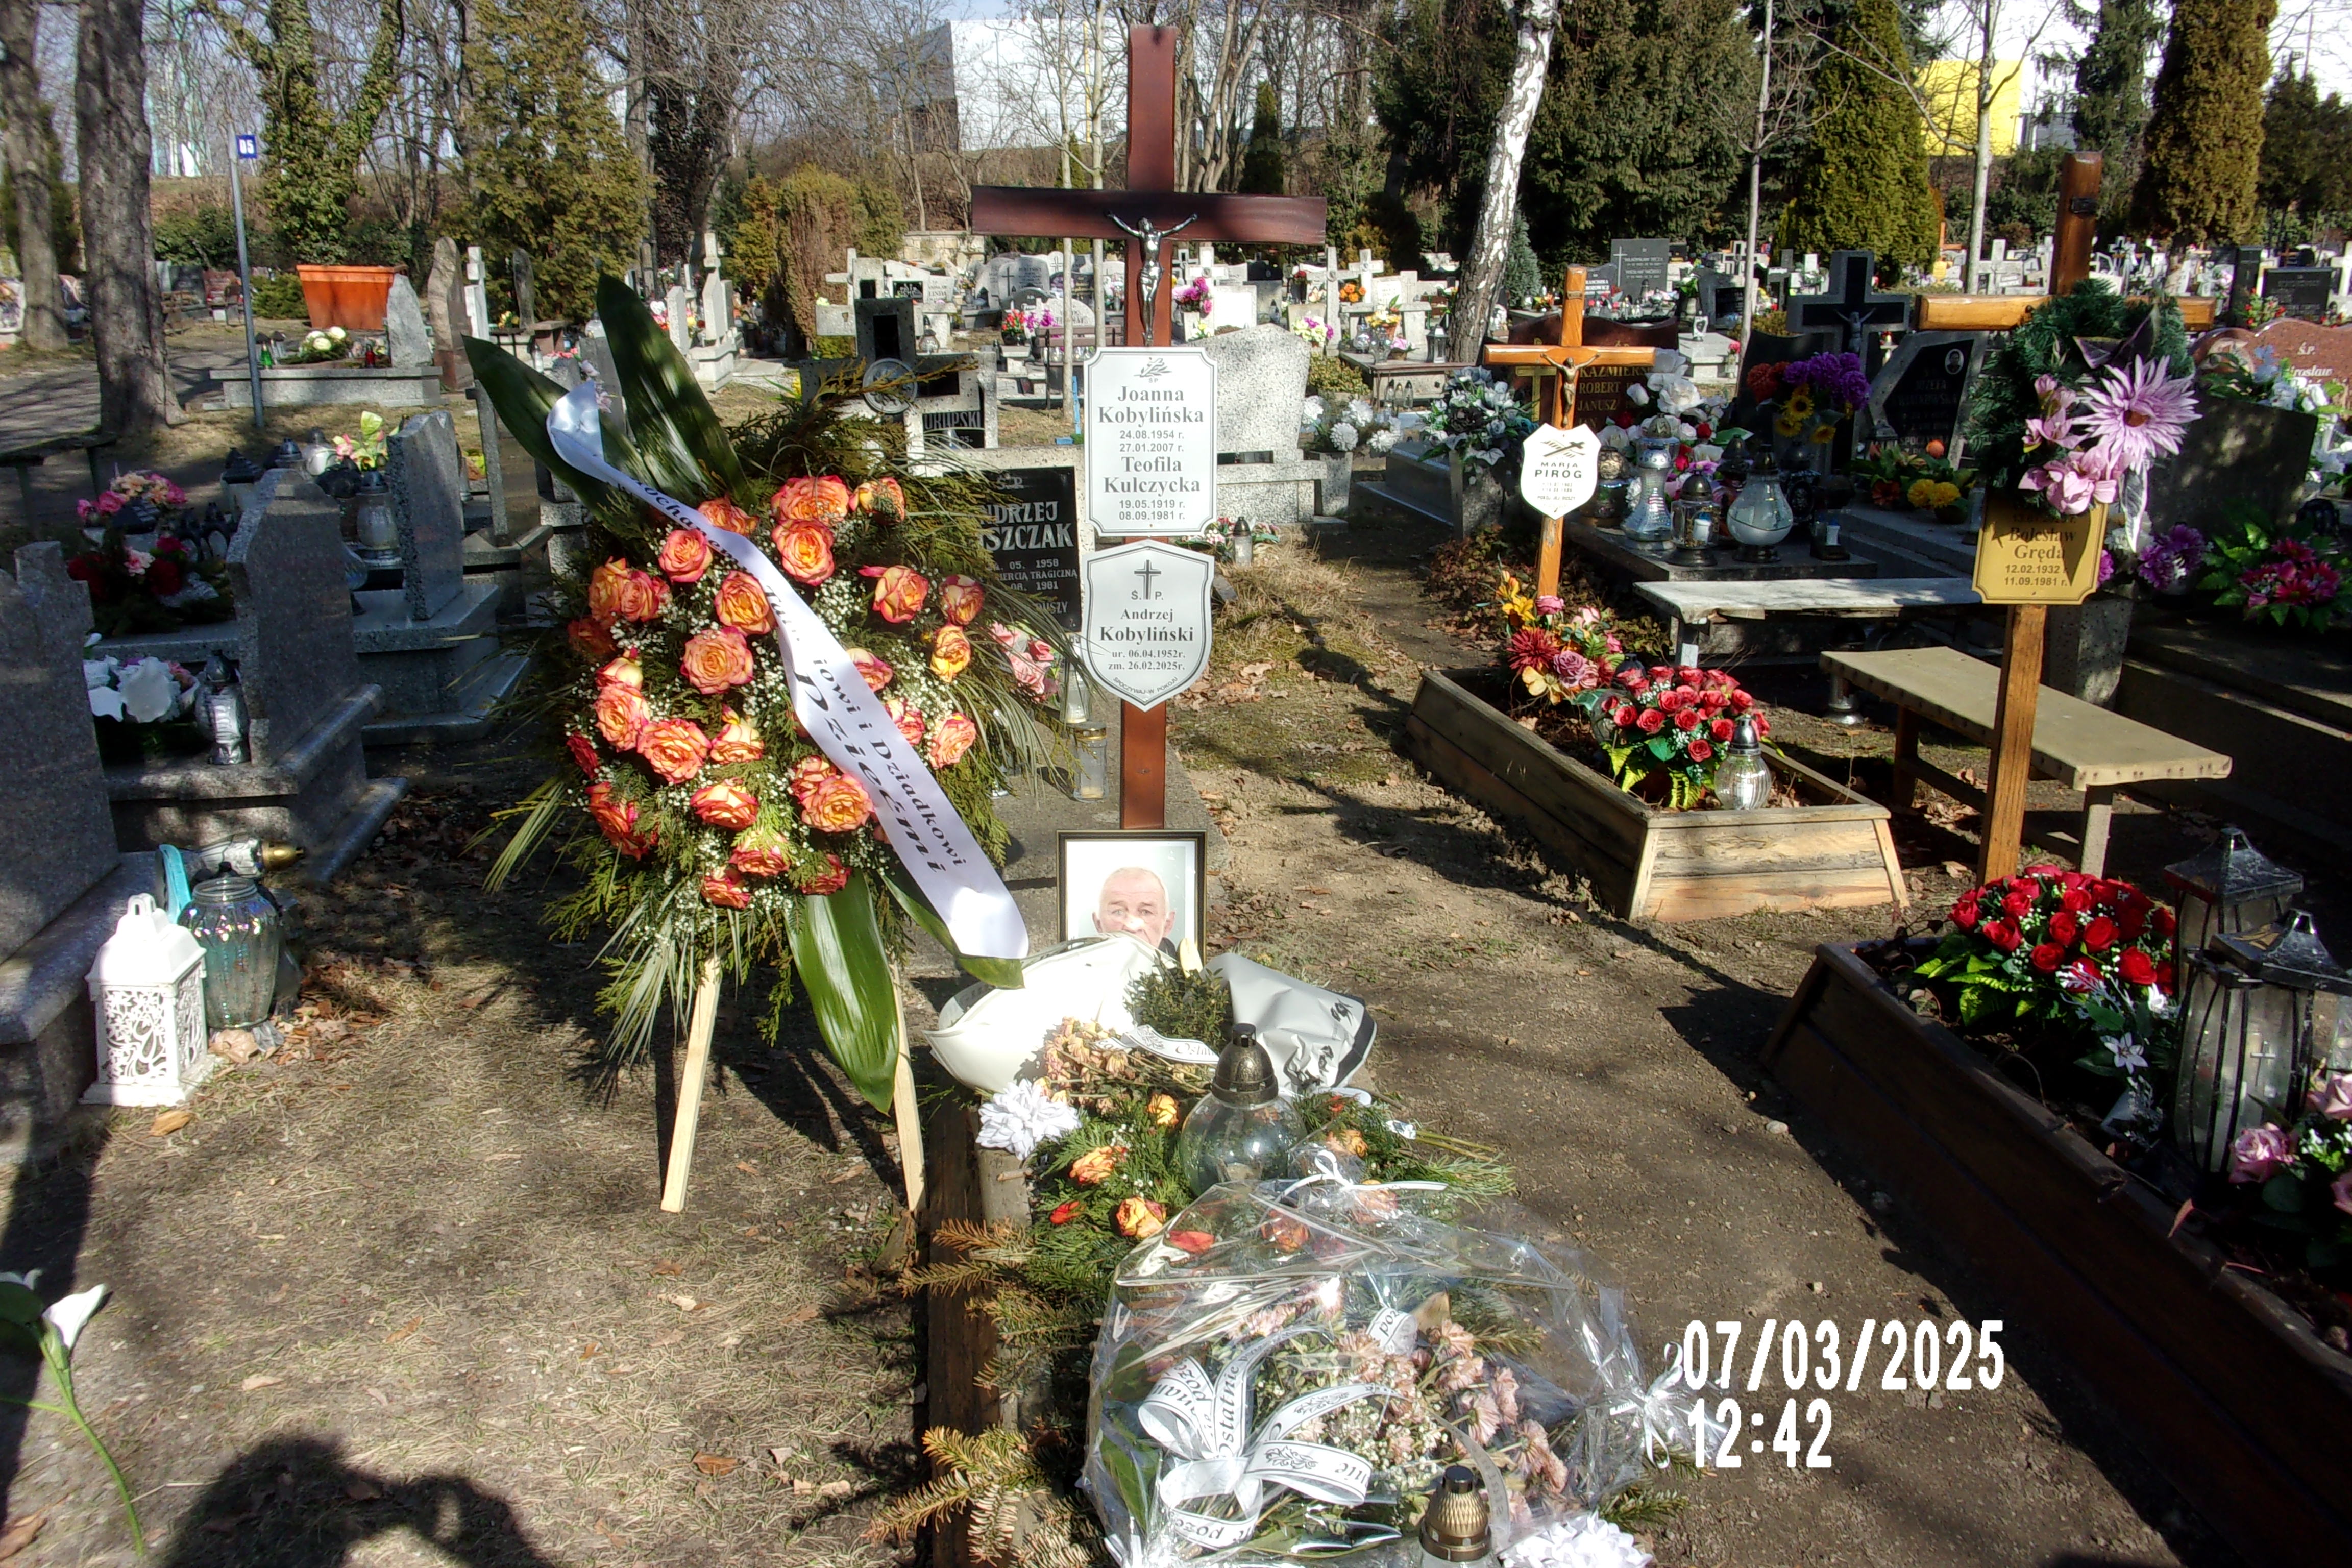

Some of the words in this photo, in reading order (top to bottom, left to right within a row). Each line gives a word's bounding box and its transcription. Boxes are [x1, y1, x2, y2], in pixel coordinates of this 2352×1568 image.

[239, 139, 254, 154] 05
[2290, 365, 2333, 377] irosław
[1118, 386, 1184, 401] Joanna
[1579, 382, 1621, 394] ROBERT
[1578, 399, 1617, 411] JANUSZ
[1098, 407, 1204, 427] Kobylińska
[1119, 431, 1174, 439] 24.08.1954
[1119, 444, 1174, 452] 27.01.2007
[1121, 456, 1182, 472] Teofila
[1104, 477, 1200, 497] Kulczycka
[1119, 500, 1175, 508] 19.05.1919
[980, 501, 1058, 525] NDRZEJ
[1119, 511, 1174, 520] 08.09.1981
[2009, 527, 2077, 542] Bolesław
[2014, 544, 2065, 563] Gręda
[1036, 558, 1059, 569] 1958
[2005, 564, 2060, 574] 12.02.1932
[997, 572, 1028, 581] IERCIĄ
[1030, 569, 1077, 579] TRAGICZNĄ
[1036, 581, 1058, 591] 1981
[2004, 577, 2057, 586] 11.09.1981
[1131, 590, 1141, 600] Ś.
[1155, 591, 1164, 600] P.
[1120, 609, 1173, 623] Andrzej
[1099, 627, 1193, 645] Kobyliński
[1129, 649, 1185, 658] 06.04.1952r.
[1128, 662, 1185, 670] 26.02.2025r.
[870, 739, 967, 867] Dziadkowi
